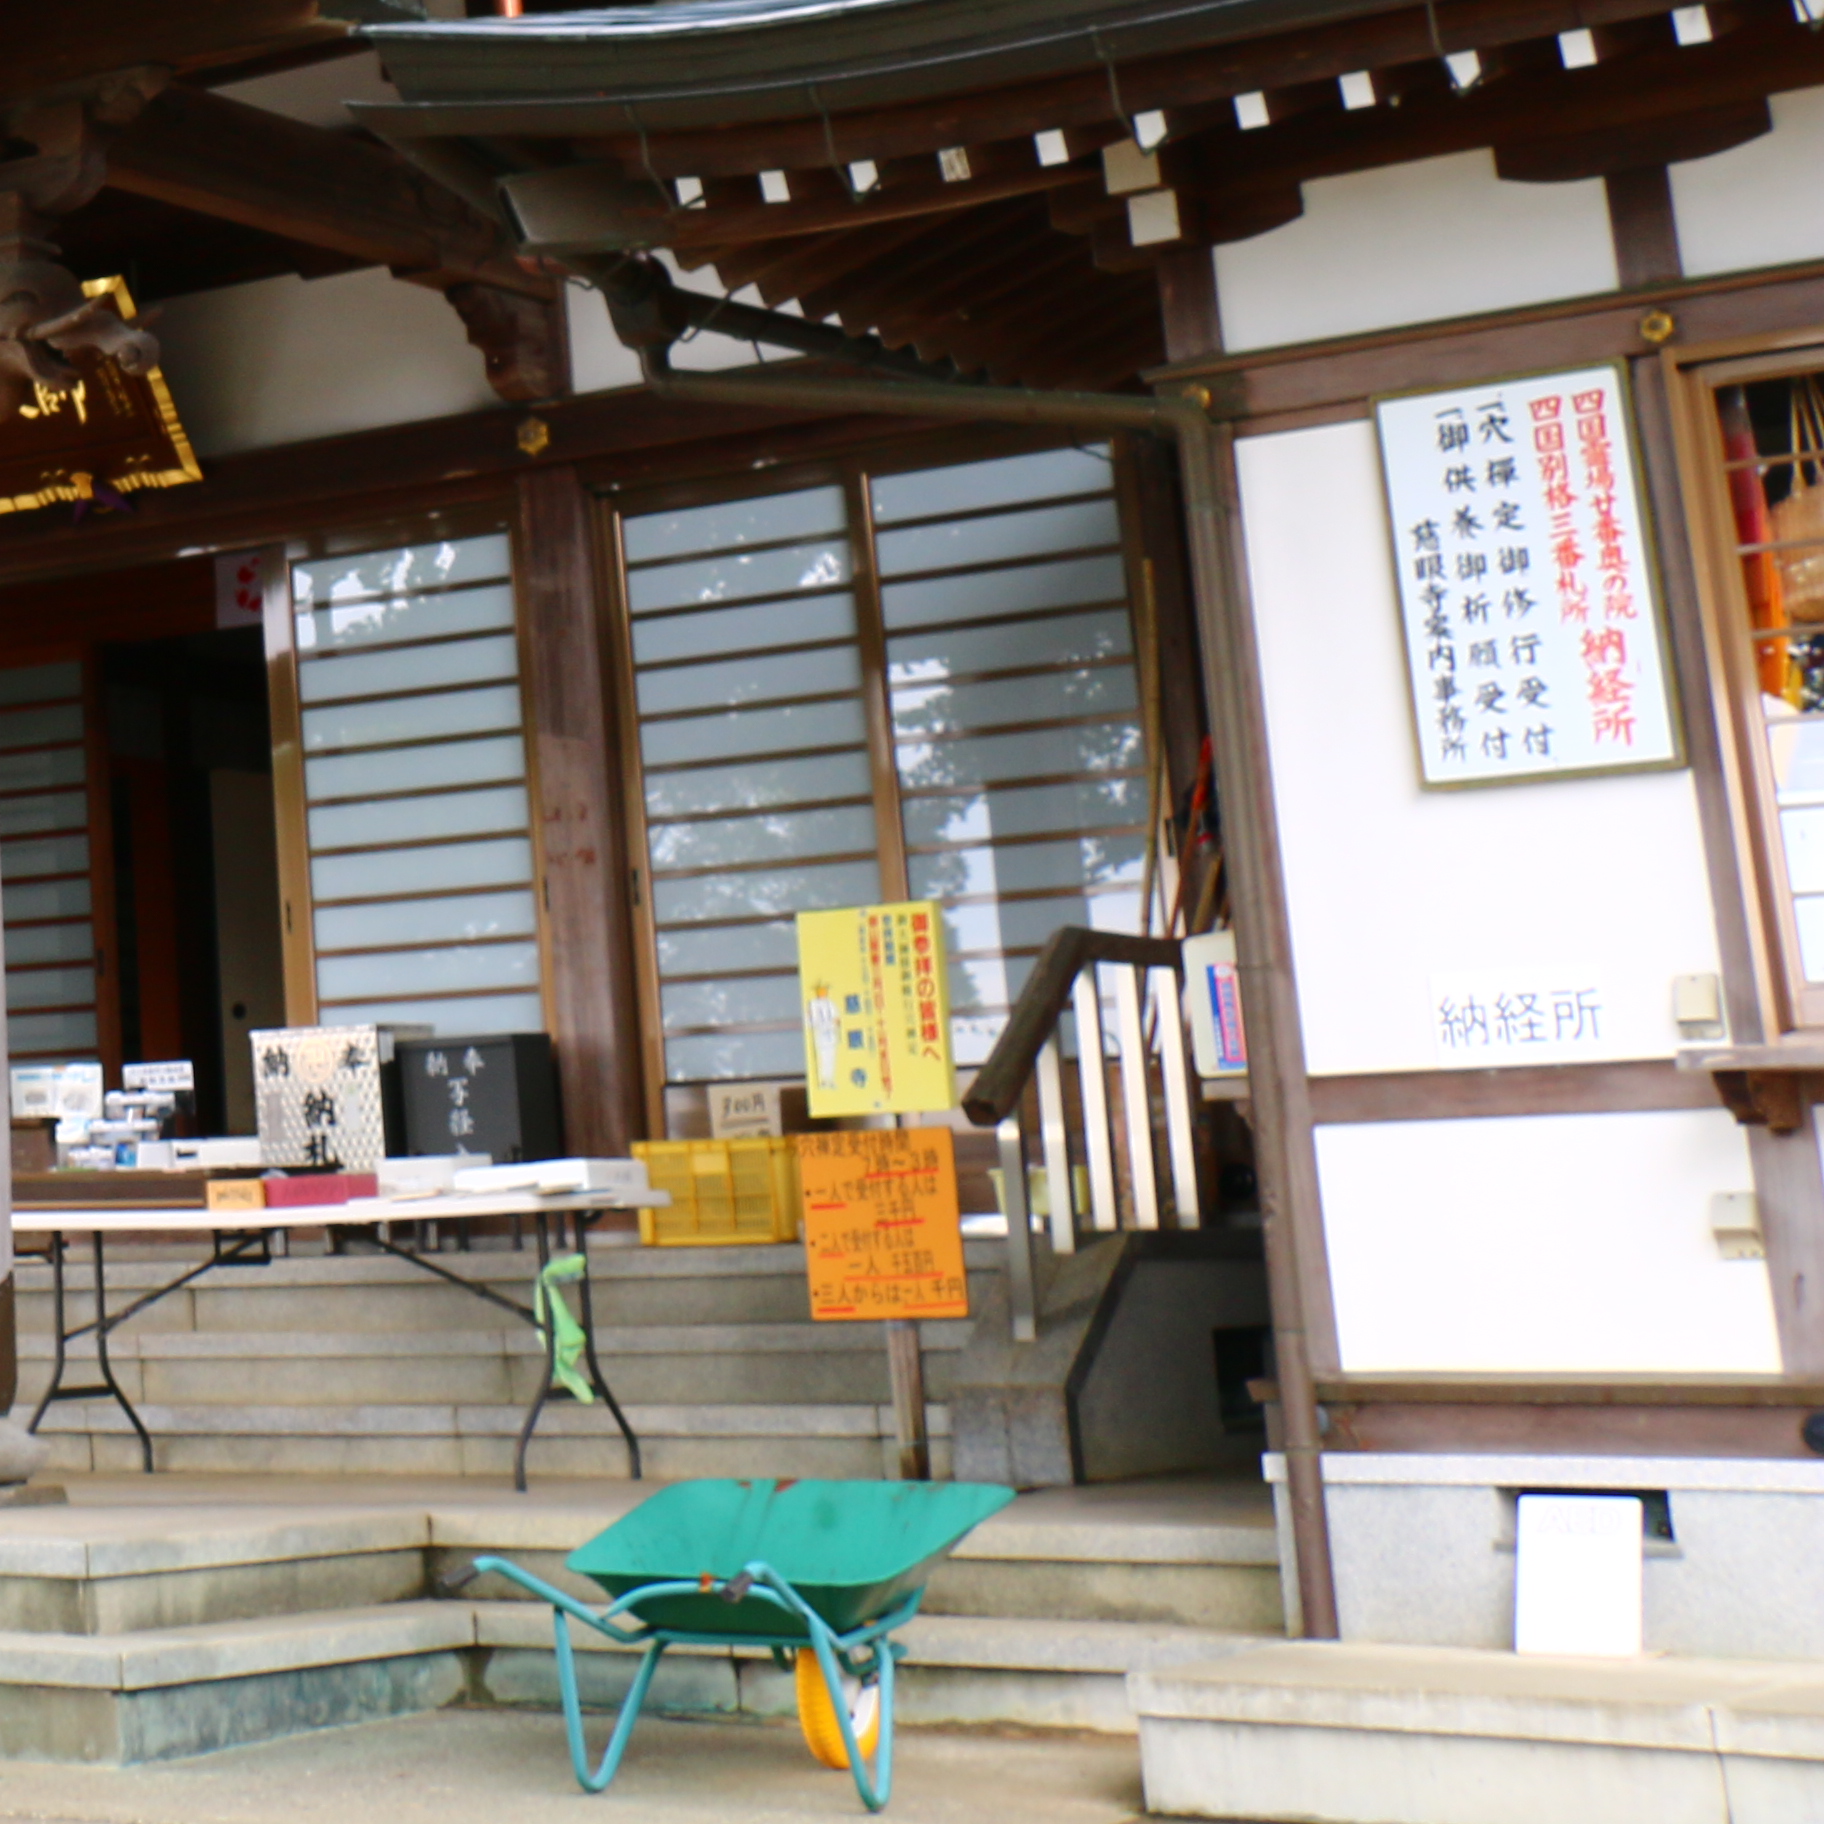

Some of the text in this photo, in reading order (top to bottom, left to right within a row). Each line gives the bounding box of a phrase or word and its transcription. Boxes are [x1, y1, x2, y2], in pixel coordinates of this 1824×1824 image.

[1580, 627, 1636, 746] 納経所
[1437, 987, 1603, 1049] 納経所
